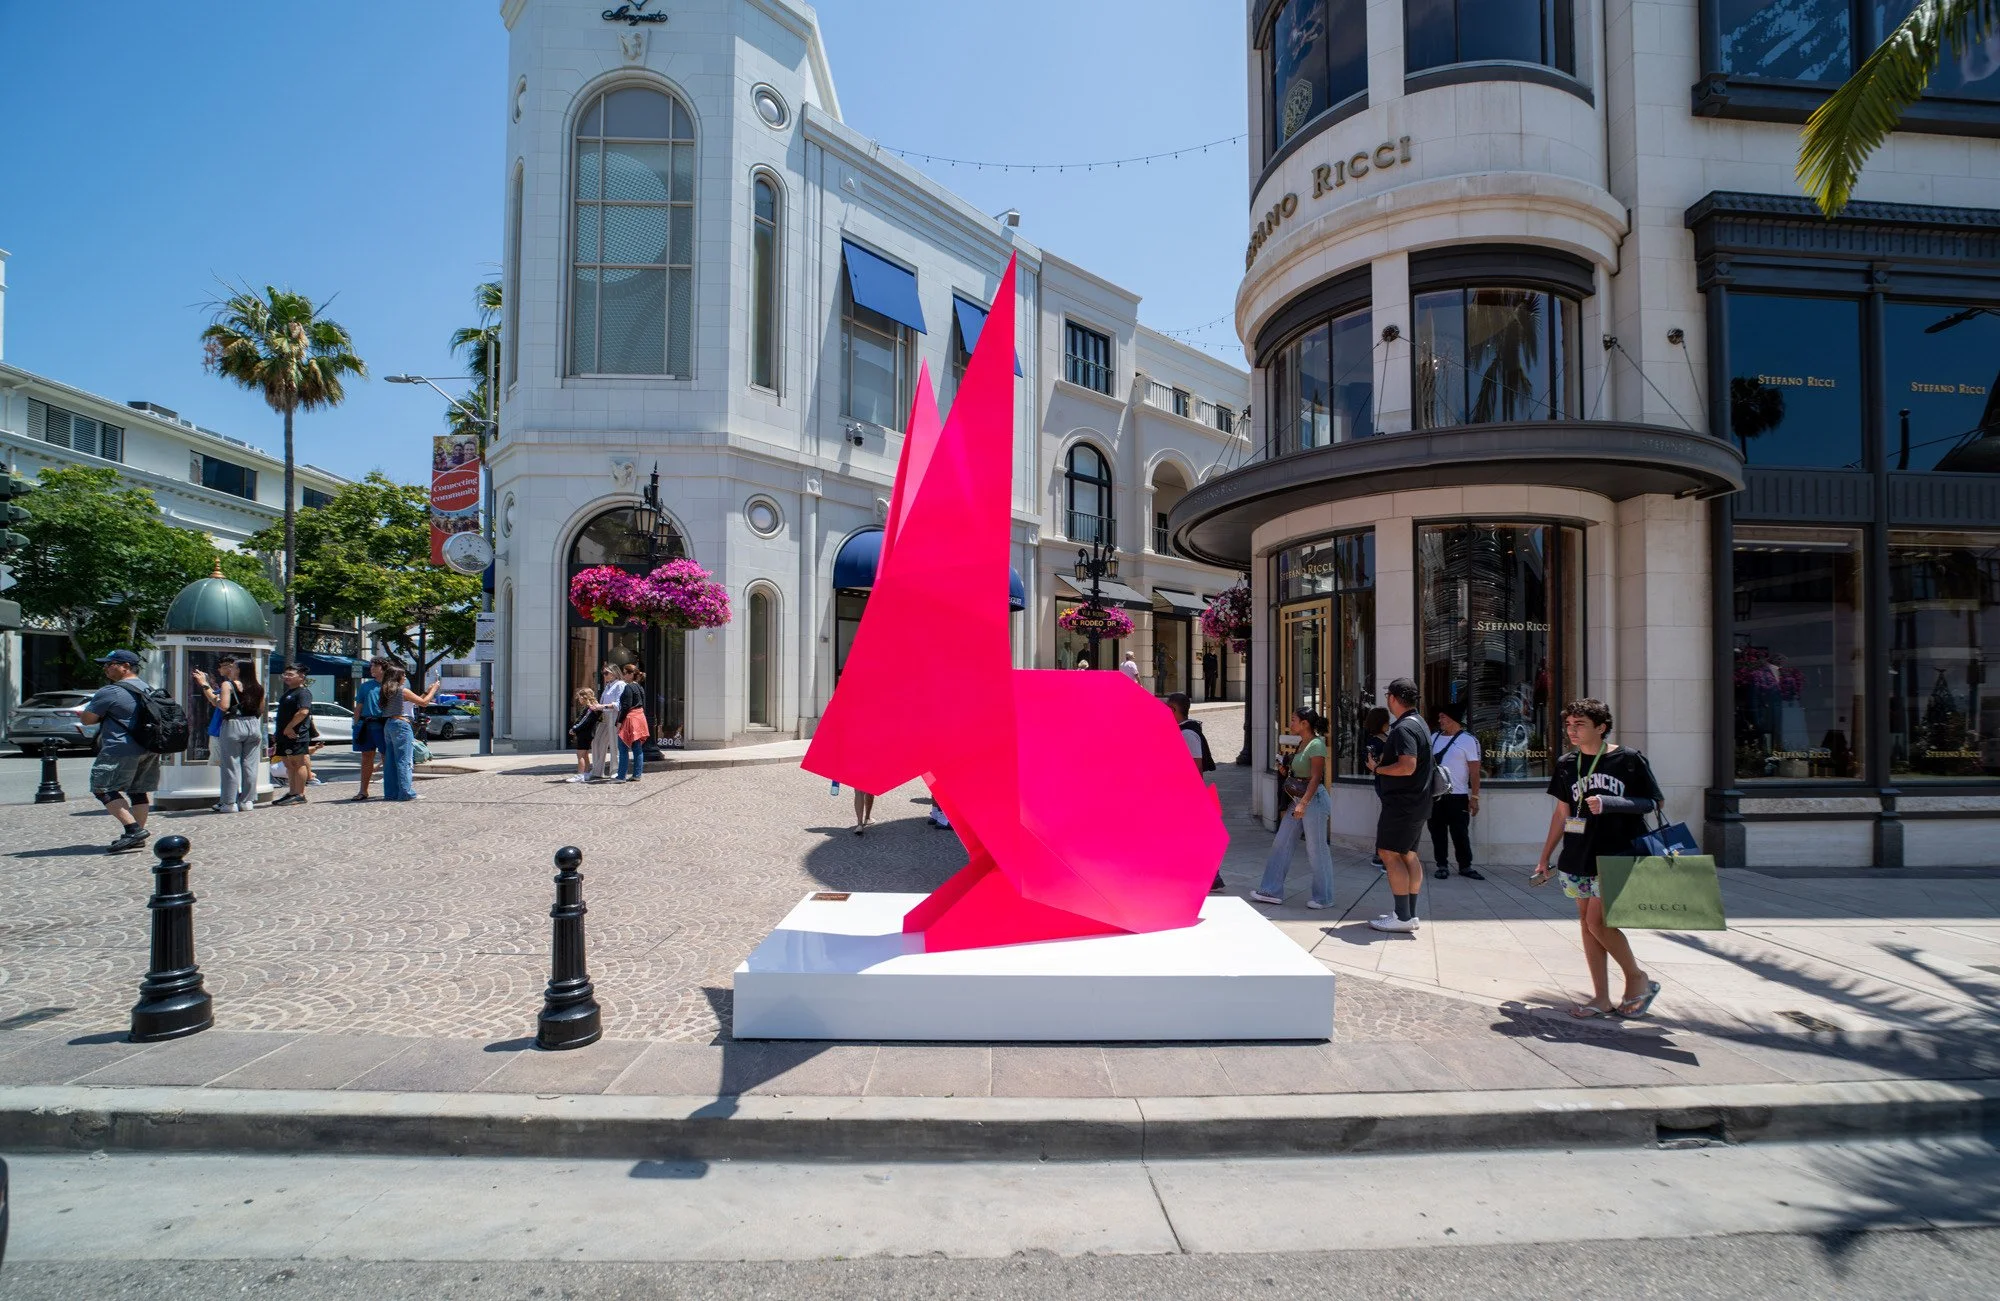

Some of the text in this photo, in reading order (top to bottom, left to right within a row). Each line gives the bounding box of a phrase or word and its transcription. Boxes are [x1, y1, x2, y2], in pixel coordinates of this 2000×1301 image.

[1311, 135, 1412, 199] RICCI
[1757, 374, 1836, 388] STEFANO RICCI
[1911, 381, 1986, 395] STEFANO RICCI
[433, 477, 478, 492] Connecting
[432, 487, 477, 502] community
[1280, 562, 1333, 580] STEFANO RICCI
[1477, 620, 1551, 632] STEFANO RICCI
[657, 737, 674, 746] 280
[1485, 748, 1548, 758] STEFANO RICCI
[1638, 903, 1687, 912] GUCCI
